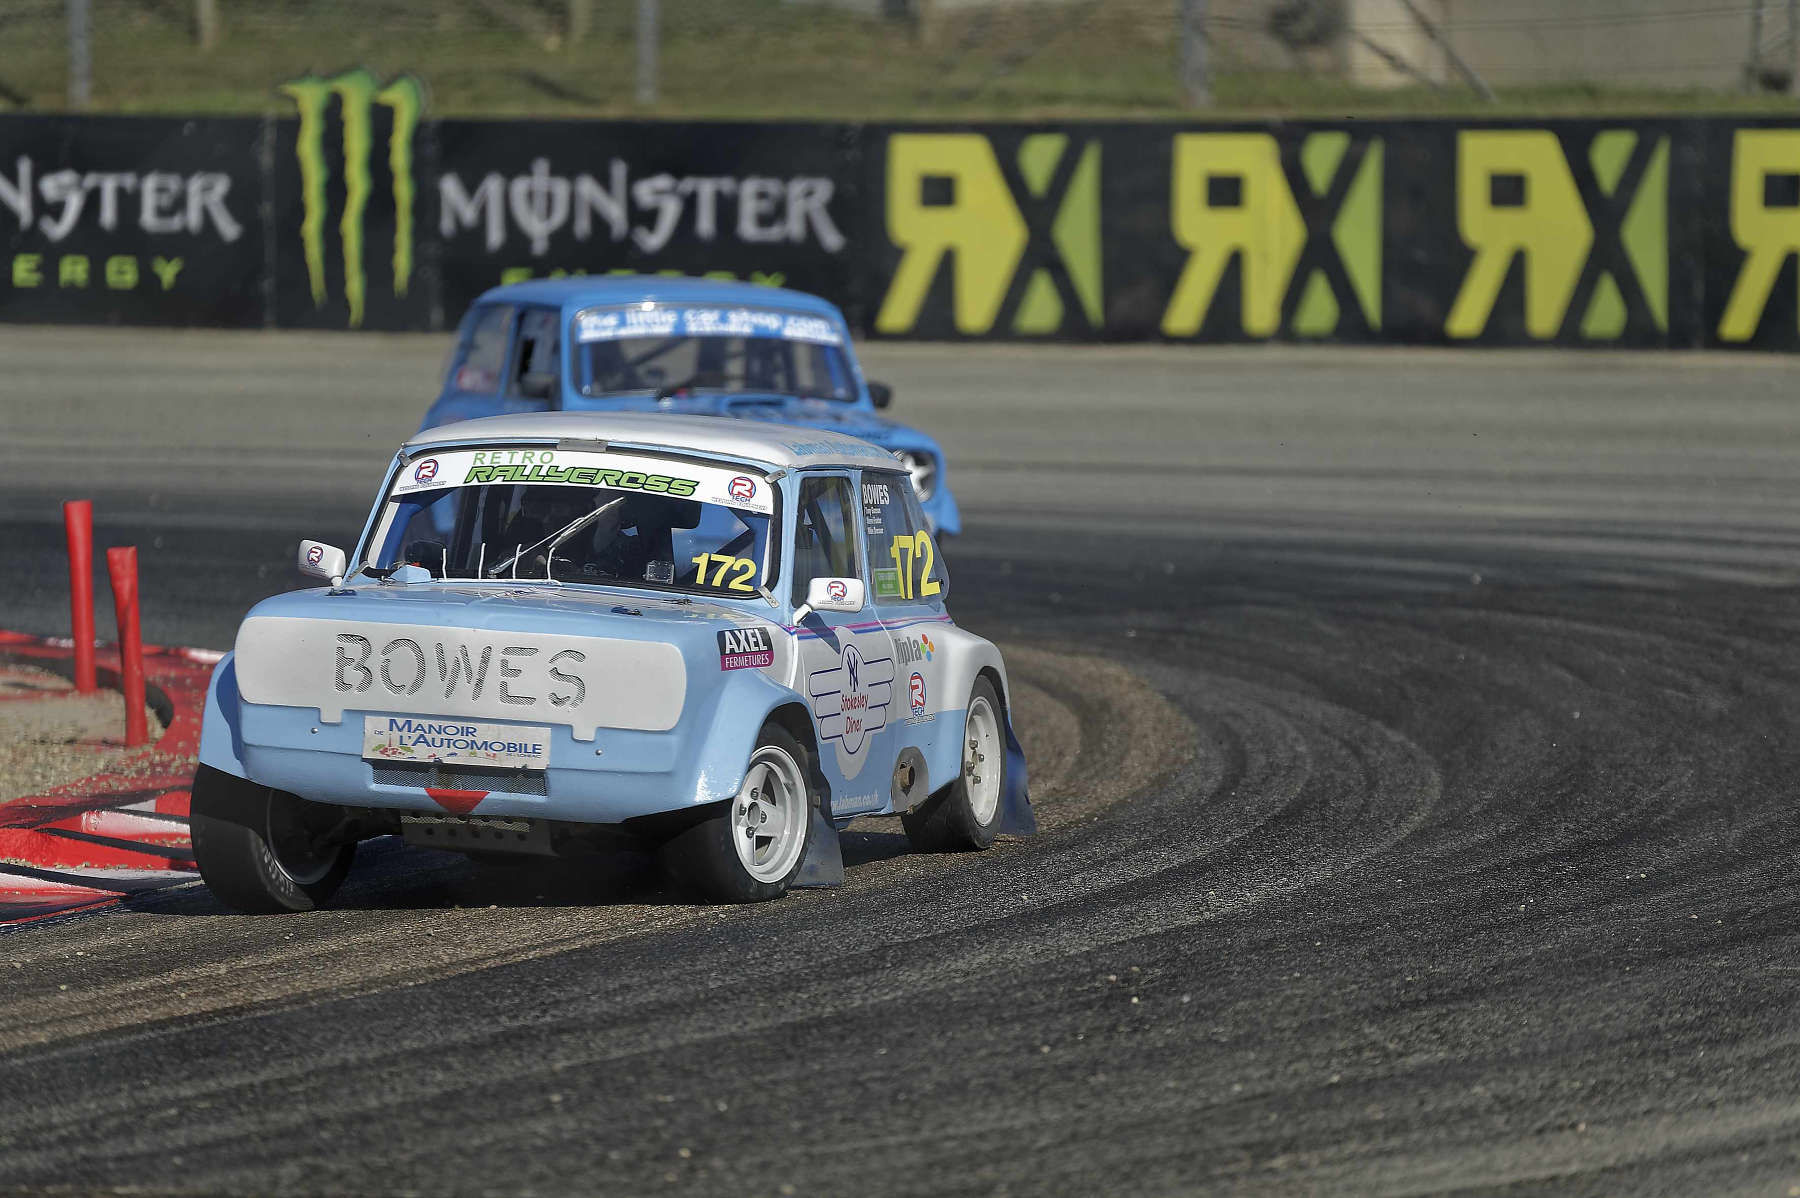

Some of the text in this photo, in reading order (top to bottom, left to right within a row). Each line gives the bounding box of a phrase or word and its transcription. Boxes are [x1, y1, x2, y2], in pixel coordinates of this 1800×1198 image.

[438, 156, 847, 256] MONSTER
[473, 451, 555, 465] RETRO
[464, 465, 701, 497] RALLYCROSS
[862, 484, 890, 505] BOWES
[691, 553, 757, 592] 172
[890, 530, 940, 600] 172
[725, 629, 768, 654] AXEL
[335, 632, 588, 711] BOWES
[725, 653, 770, 668] FERMETURES
[841, 692, 869, 712] Stokesley
[388, 718, 478, 738] MANOIR
[845, 716, 863, 734] Diner
